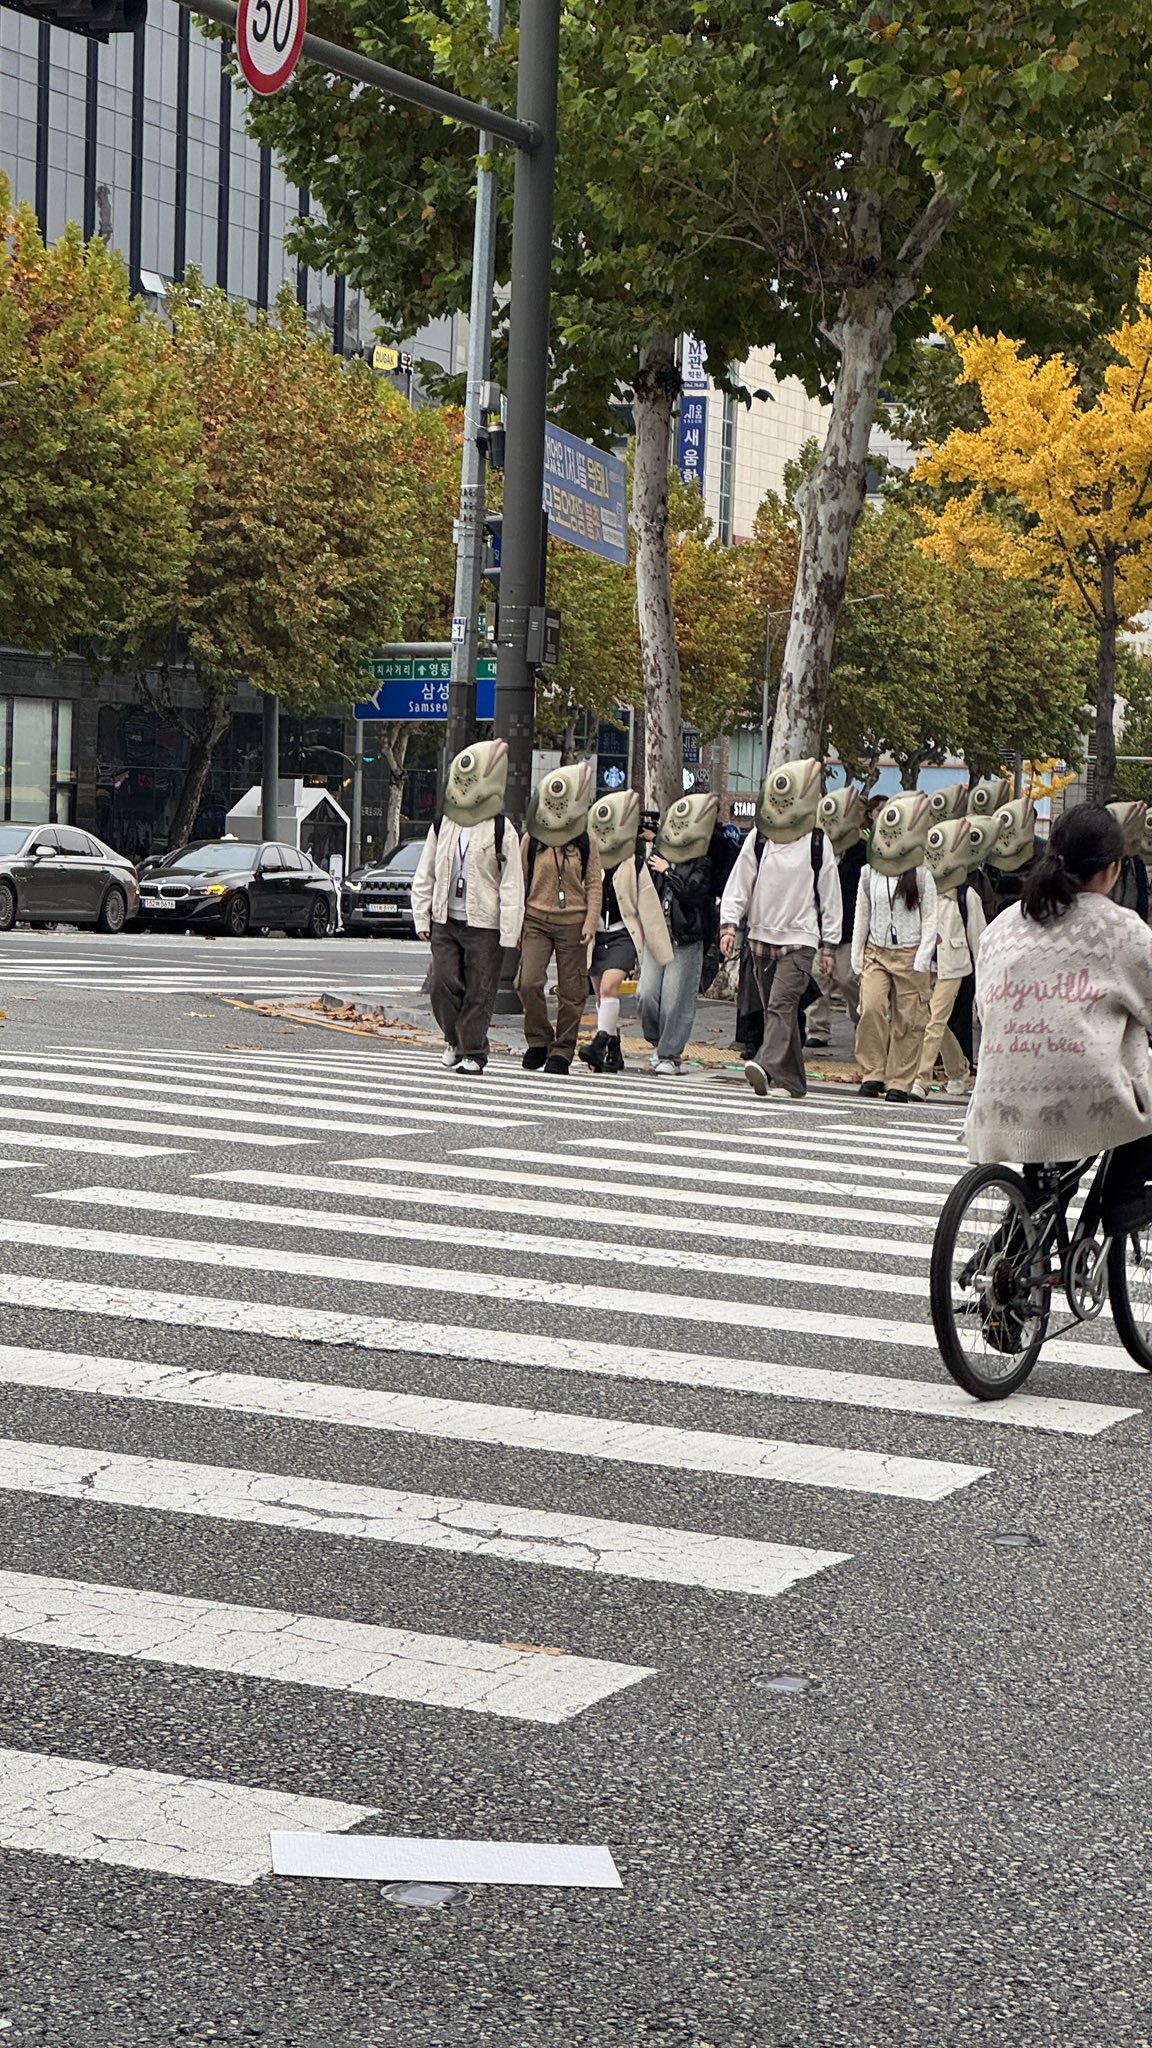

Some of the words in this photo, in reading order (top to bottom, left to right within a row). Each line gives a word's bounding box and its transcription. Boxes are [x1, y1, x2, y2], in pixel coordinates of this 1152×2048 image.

[252, 0, 293, 52] 50
[408, 701, 448, 713] Samseo
[734, 802, 755, 816] STARB
[1009, 1036, 1041, 1057] day
